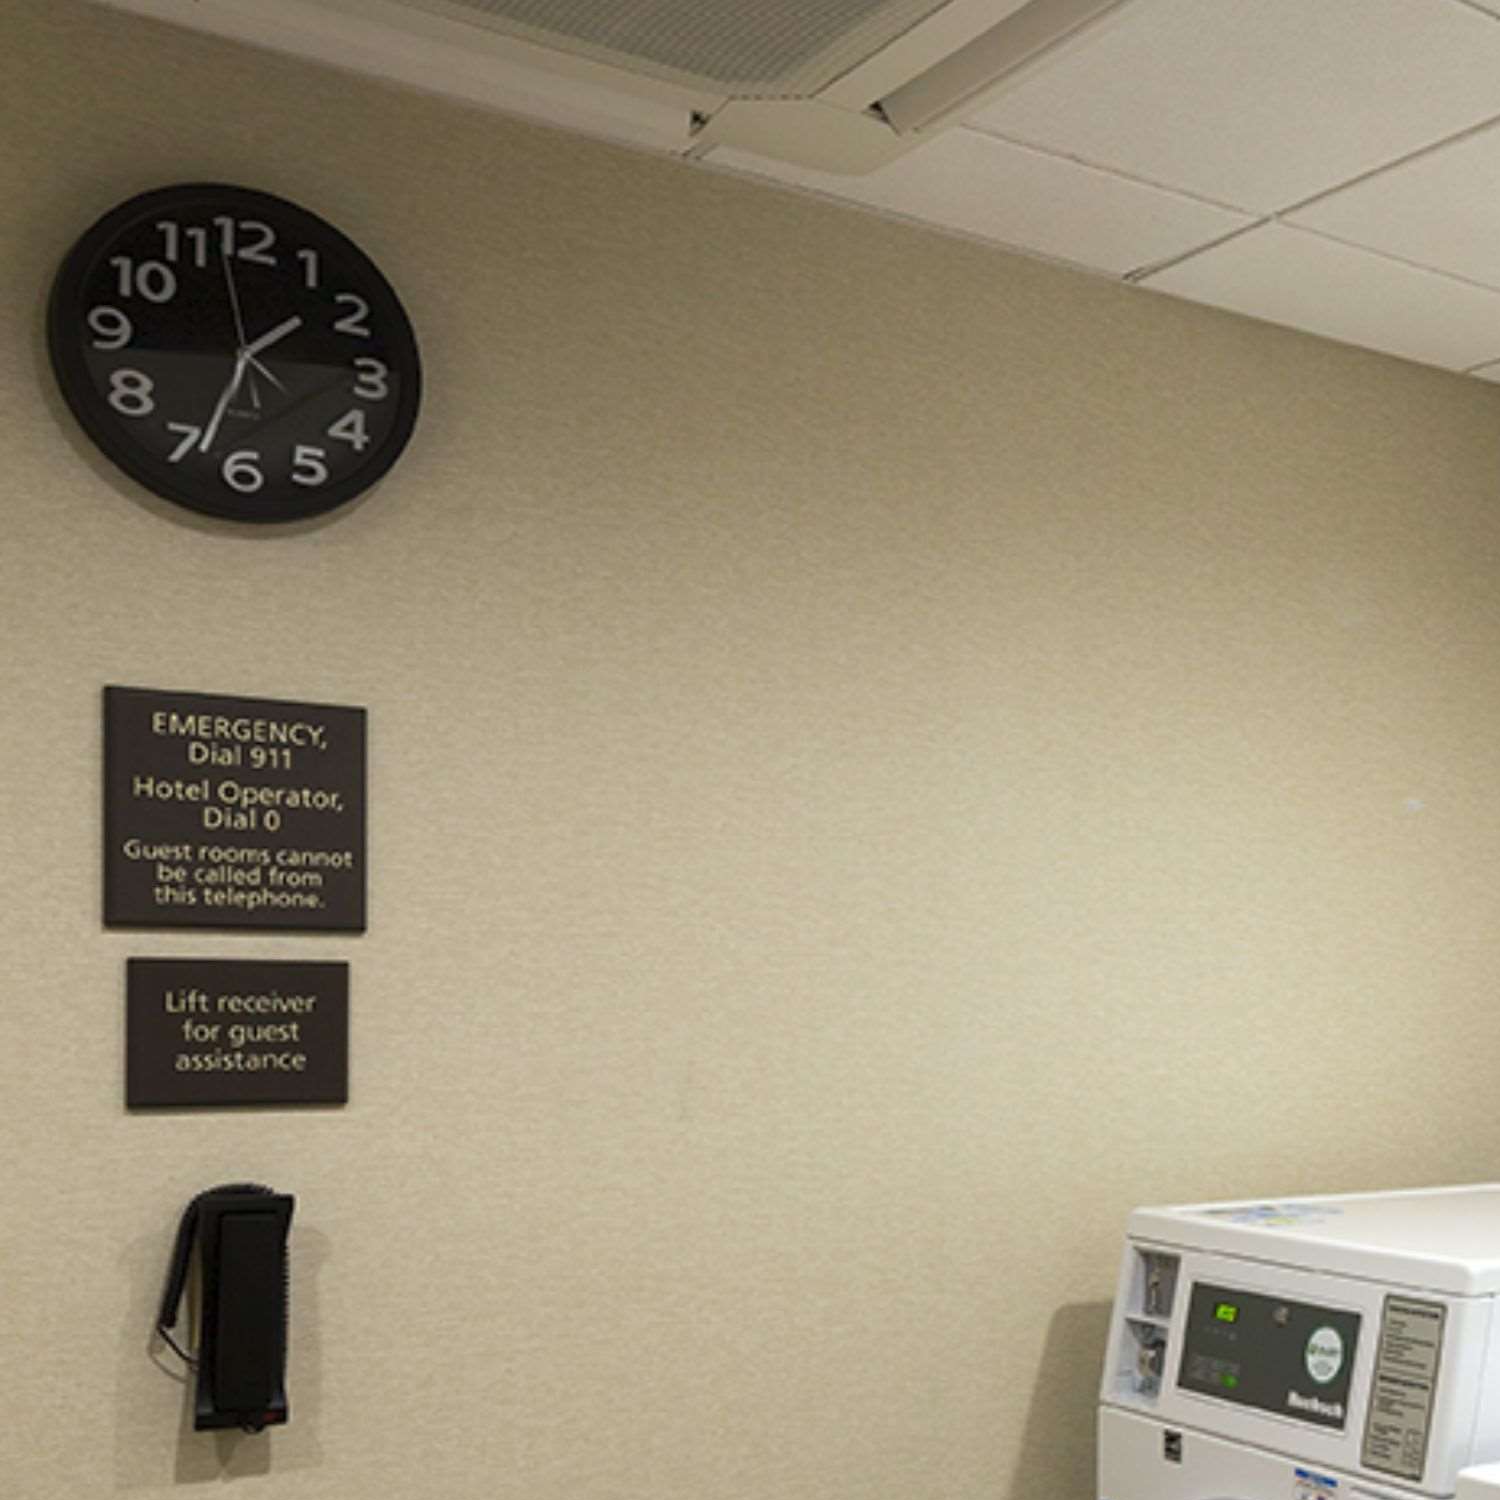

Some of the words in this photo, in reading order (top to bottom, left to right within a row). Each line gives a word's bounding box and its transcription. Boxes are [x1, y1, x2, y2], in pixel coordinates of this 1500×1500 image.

[156, 221, 207, 268] 11
[213, 216, 277, 266] 12
[109, 256, 177, 302] 10
[297, 249, 319, 288] 1
[87, 306, 133, 349] 9
[333, 294, 371, 337] 2
[107, 369, 155, 416] 8
[353, 357, 388, 399] 3
[167, 422, 200, 463] 7
[327, 408, 369, 451] 4
[222, 451, 264, 493] 6
[292, 445, 328, 486] 5
[152, 712, 329, 750] EMERGENCY,
[188, 742, 242, 766] Dial
[250, 747, 293, 769] 911
[132, 776, 210, 802] Hotel
[217, 780, 345, 812] Operator,
[203, 807, 257, 830] Dial
[263, 808, 281, 831] 0
[123, 839, 193, 862] Guest
[198, 843, 270, 865] rooms
[275, 849, 353, 869] cannot
[156, 863, 185, 882] be
[194, 865, 262, 886] called
[268, 867, 323, 887] from
[153, 884, 197, 905] this
[203, 887, 326, 910] telephone.
[164, 990, 210, 1014] Lift
[217, 990, 316, 1014] receiver
[182, 1019, 220, 1043] for
[228, 1023, 300, 1048] guest
[174, 1048, 307, 1072] assistance
